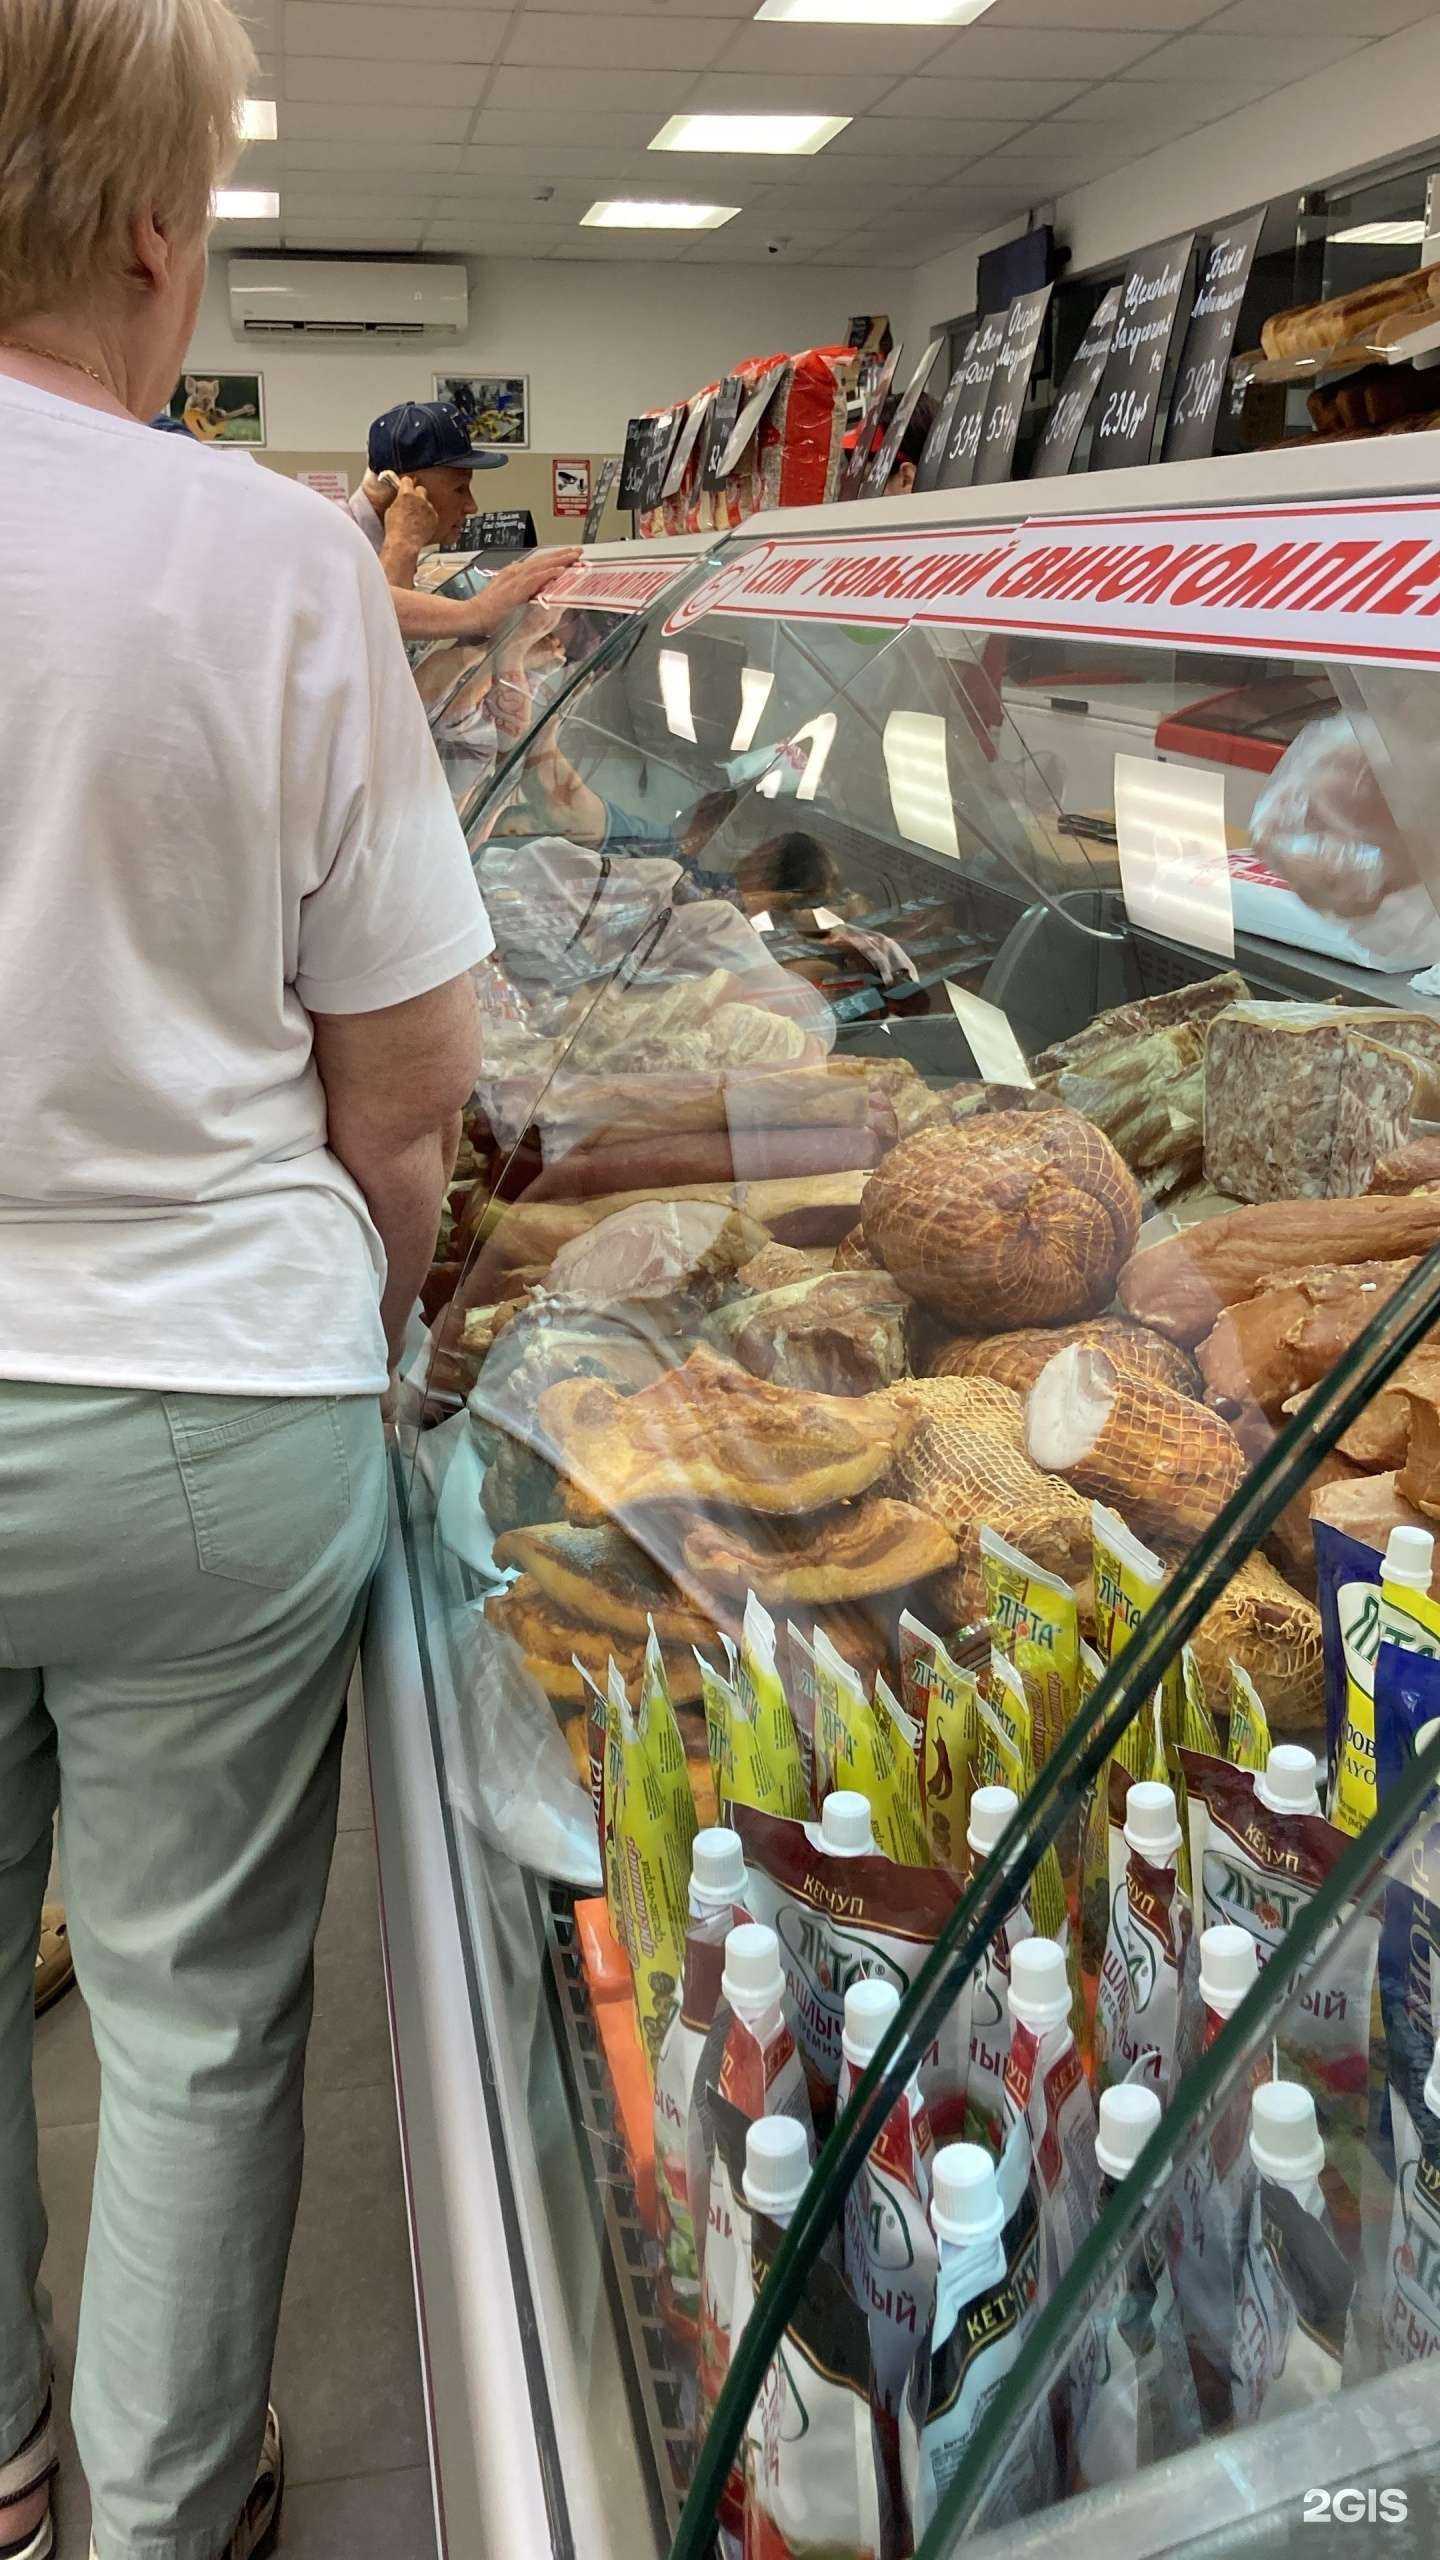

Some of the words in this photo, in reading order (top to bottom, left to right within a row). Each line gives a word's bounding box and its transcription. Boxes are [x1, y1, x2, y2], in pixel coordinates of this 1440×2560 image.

[995, 1595, 1054, 1650] ЯНТА
[914, 1661, 957, 1710] ЯНТА
[803, 1873, 864, 1916] КЕТЧУП
